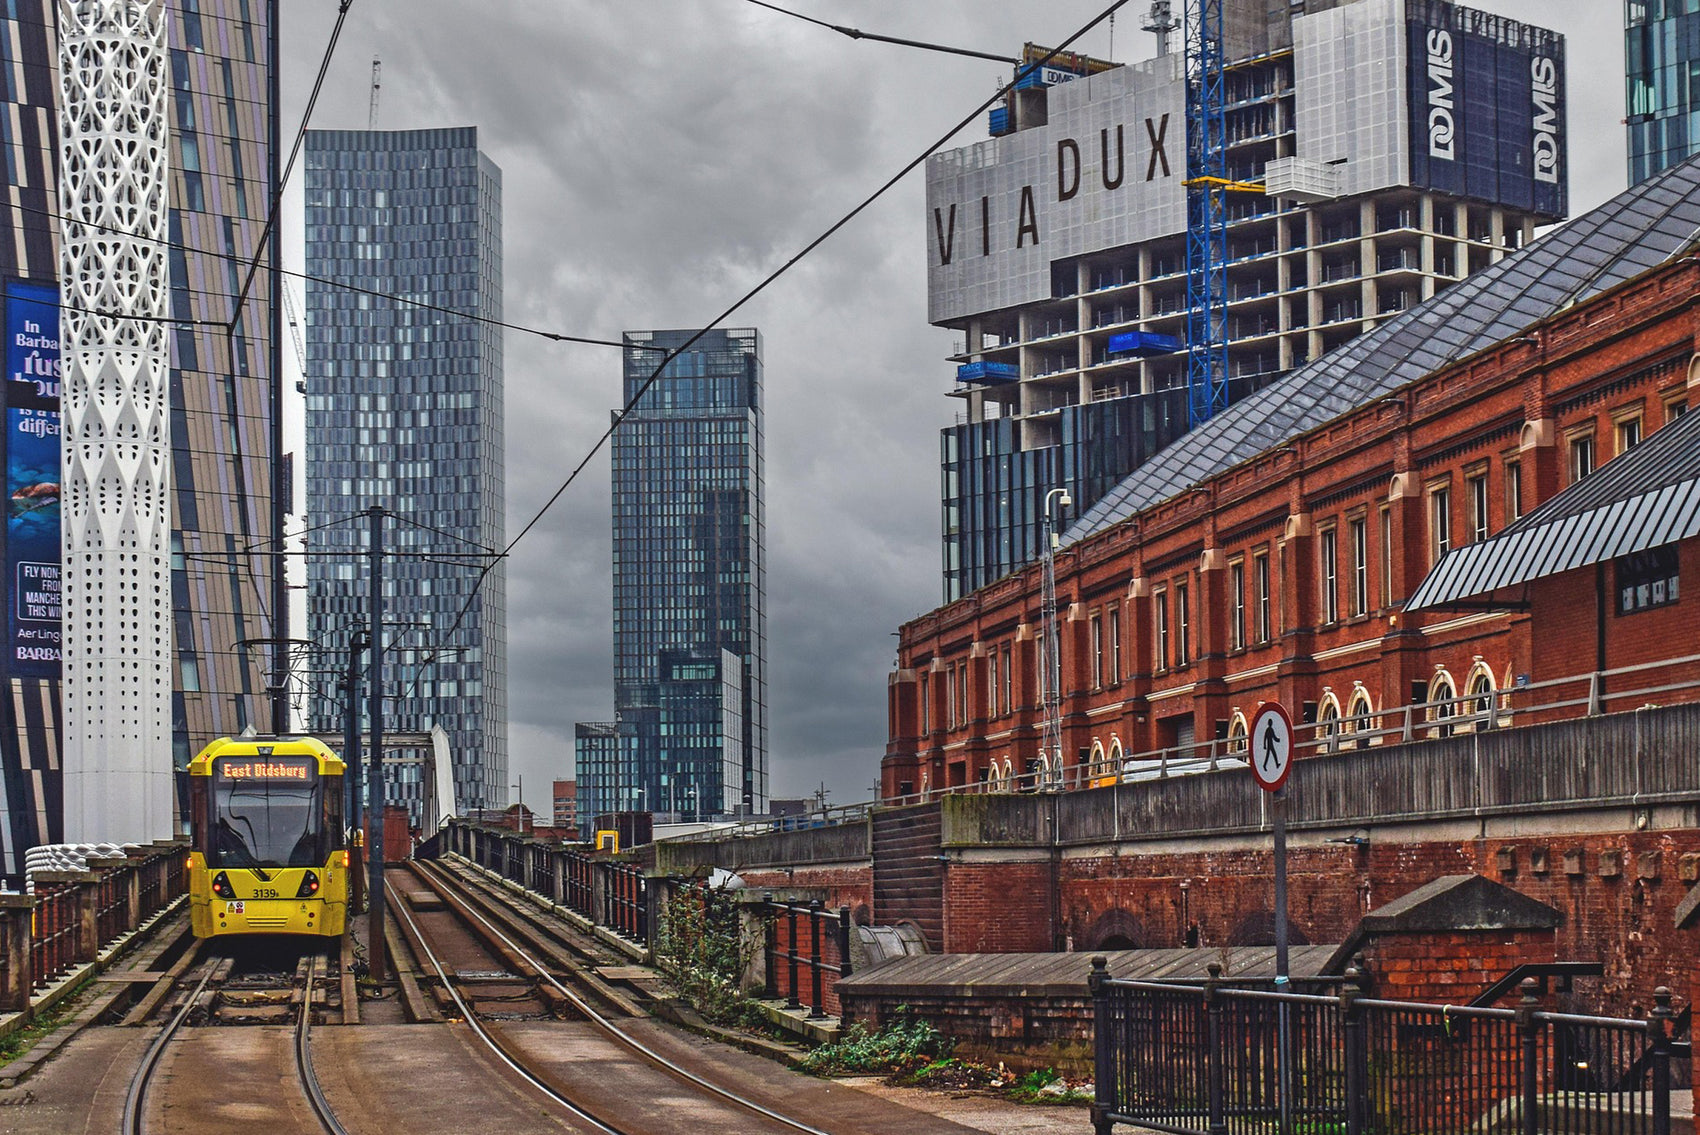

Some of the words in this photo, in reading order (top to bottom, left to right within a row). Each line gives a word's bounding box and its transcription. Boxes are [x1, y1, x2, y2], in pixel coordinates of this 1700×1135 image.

[24, 320, 40, 333] In
[16, 333, 60, 350] Barba
[24, 566, 39, 578] FLY
[25, 592, 62, 605] MANCHE
[27, 605, 47, 617] THIS
[18, 628, 37, 638] Aer
[224, 763, 252, 777] East
[254, 762, 307, 779] Didsbury
